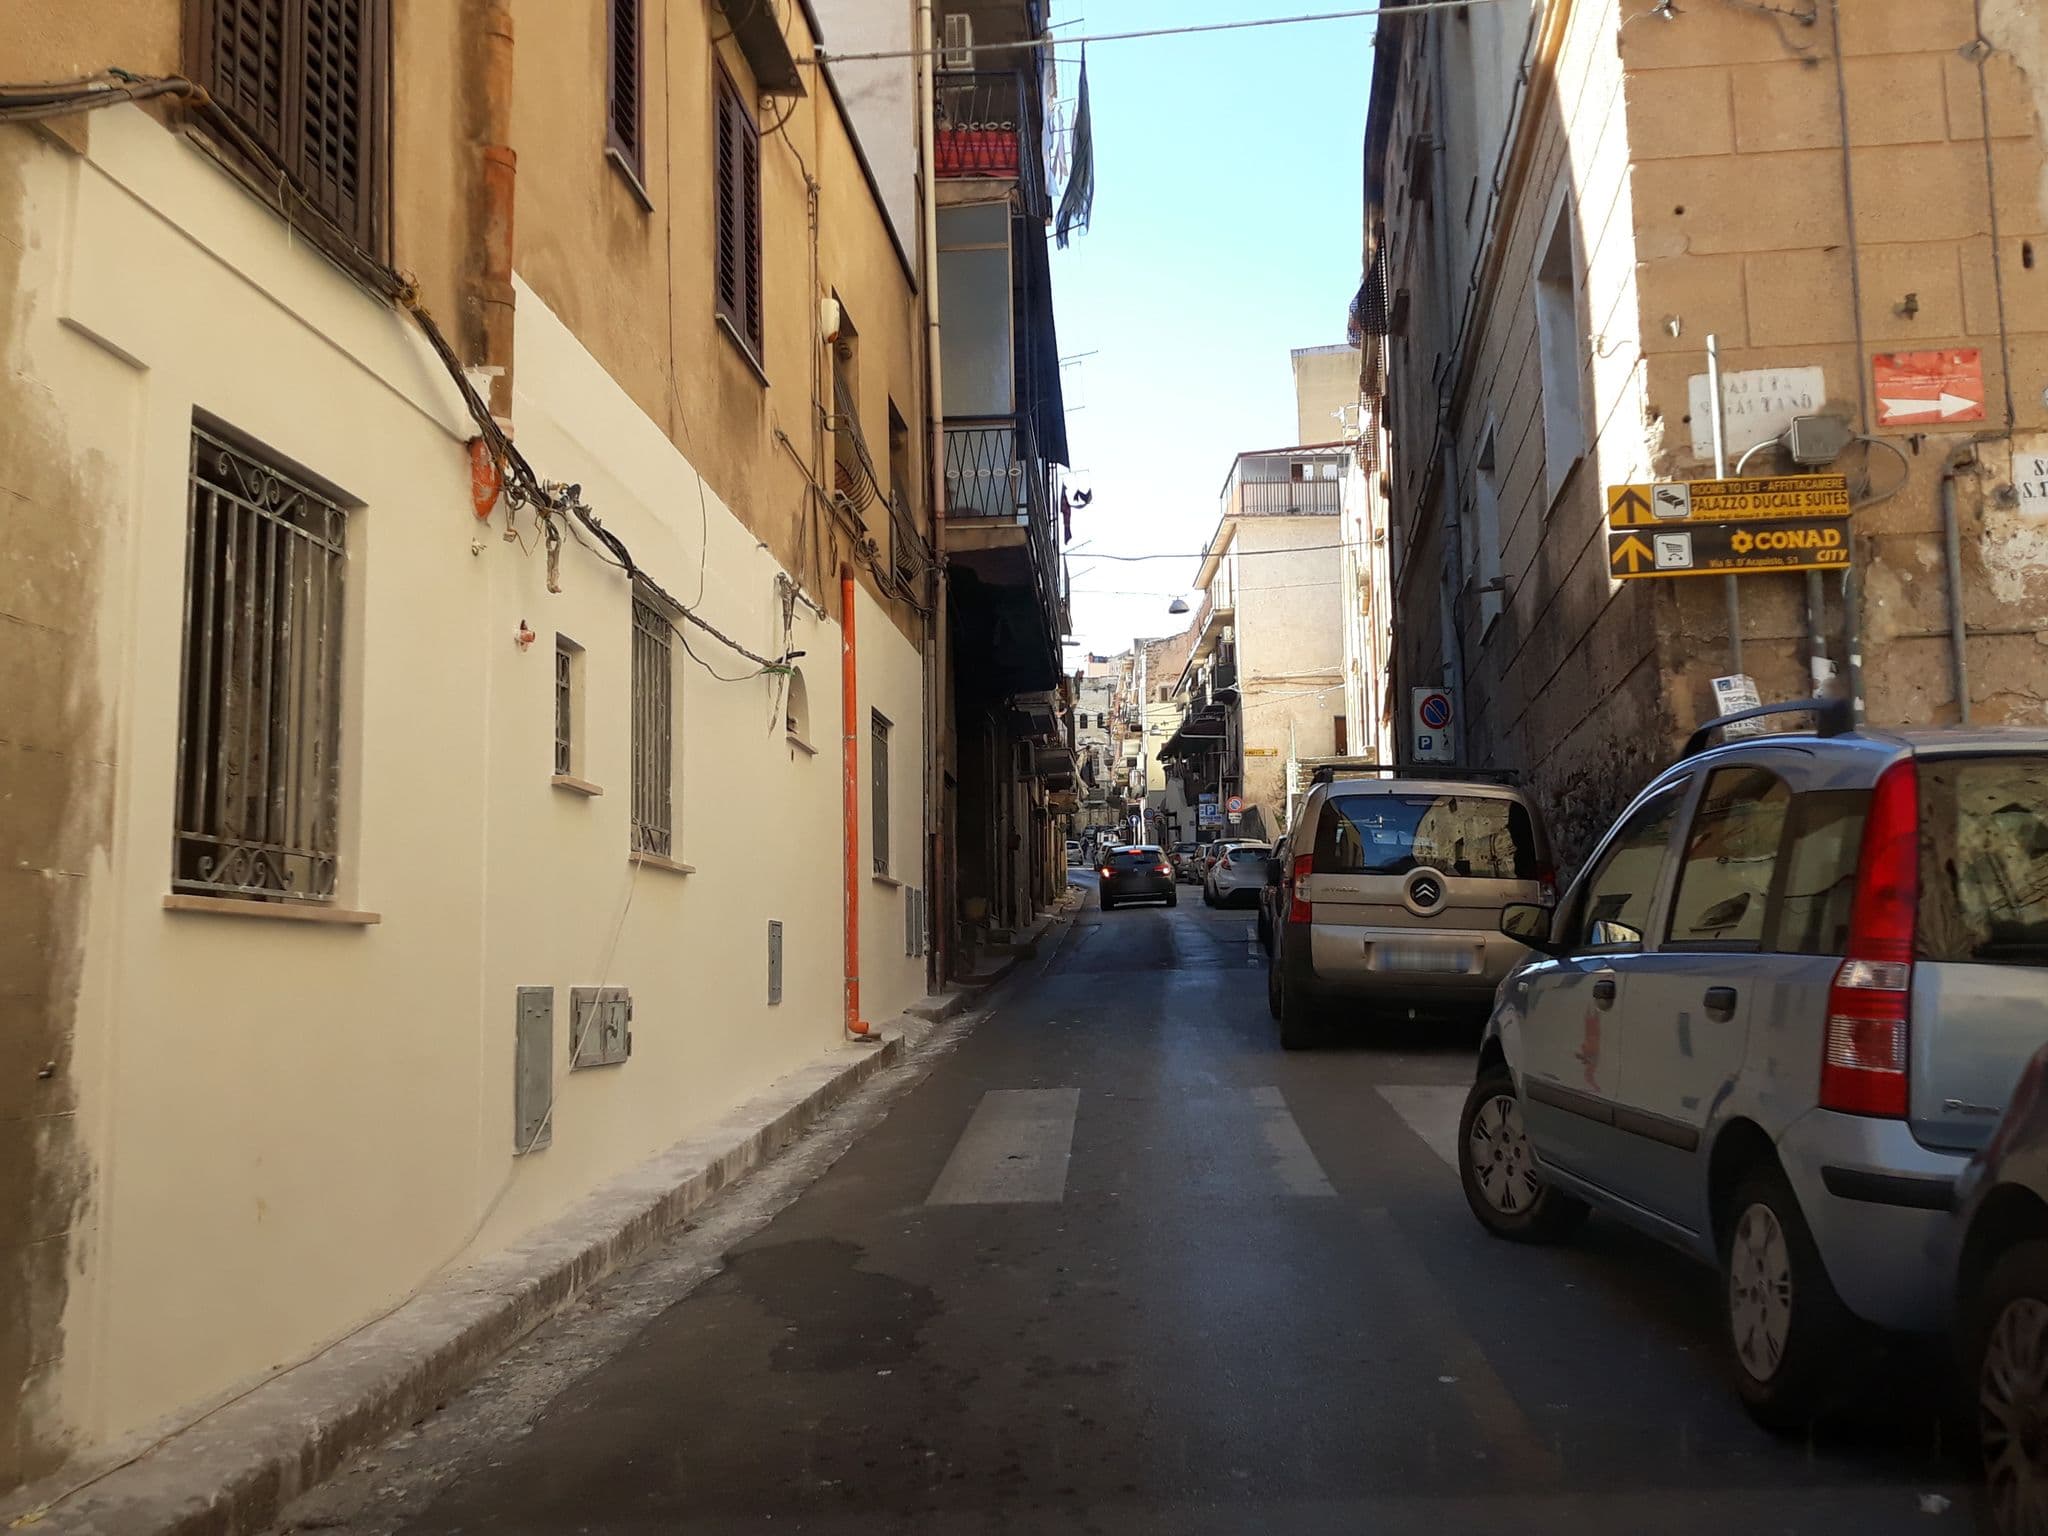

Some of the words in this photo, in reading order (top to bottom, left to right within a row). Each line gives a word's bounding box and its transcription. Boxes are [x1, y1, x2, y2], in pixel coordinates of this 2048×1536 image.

[1691, 483, 1727, 495] ROOMS
[1728, 483, 1742, 494] TO
[1743, 481, 1761, 493] LET
[1768, 479, 1845, 491] AFFITTACAMERE
[1691, 496, 1749, 511] PALAZZO
[1753, 493, 1801, 509] DUCALE
[1806, 491, 1848, 506] SUITES
[1755, 529, 1841, 550] CONAD
[1817, 549, 1848, 562] CITY
[1421, 737, 1431, 748] P
